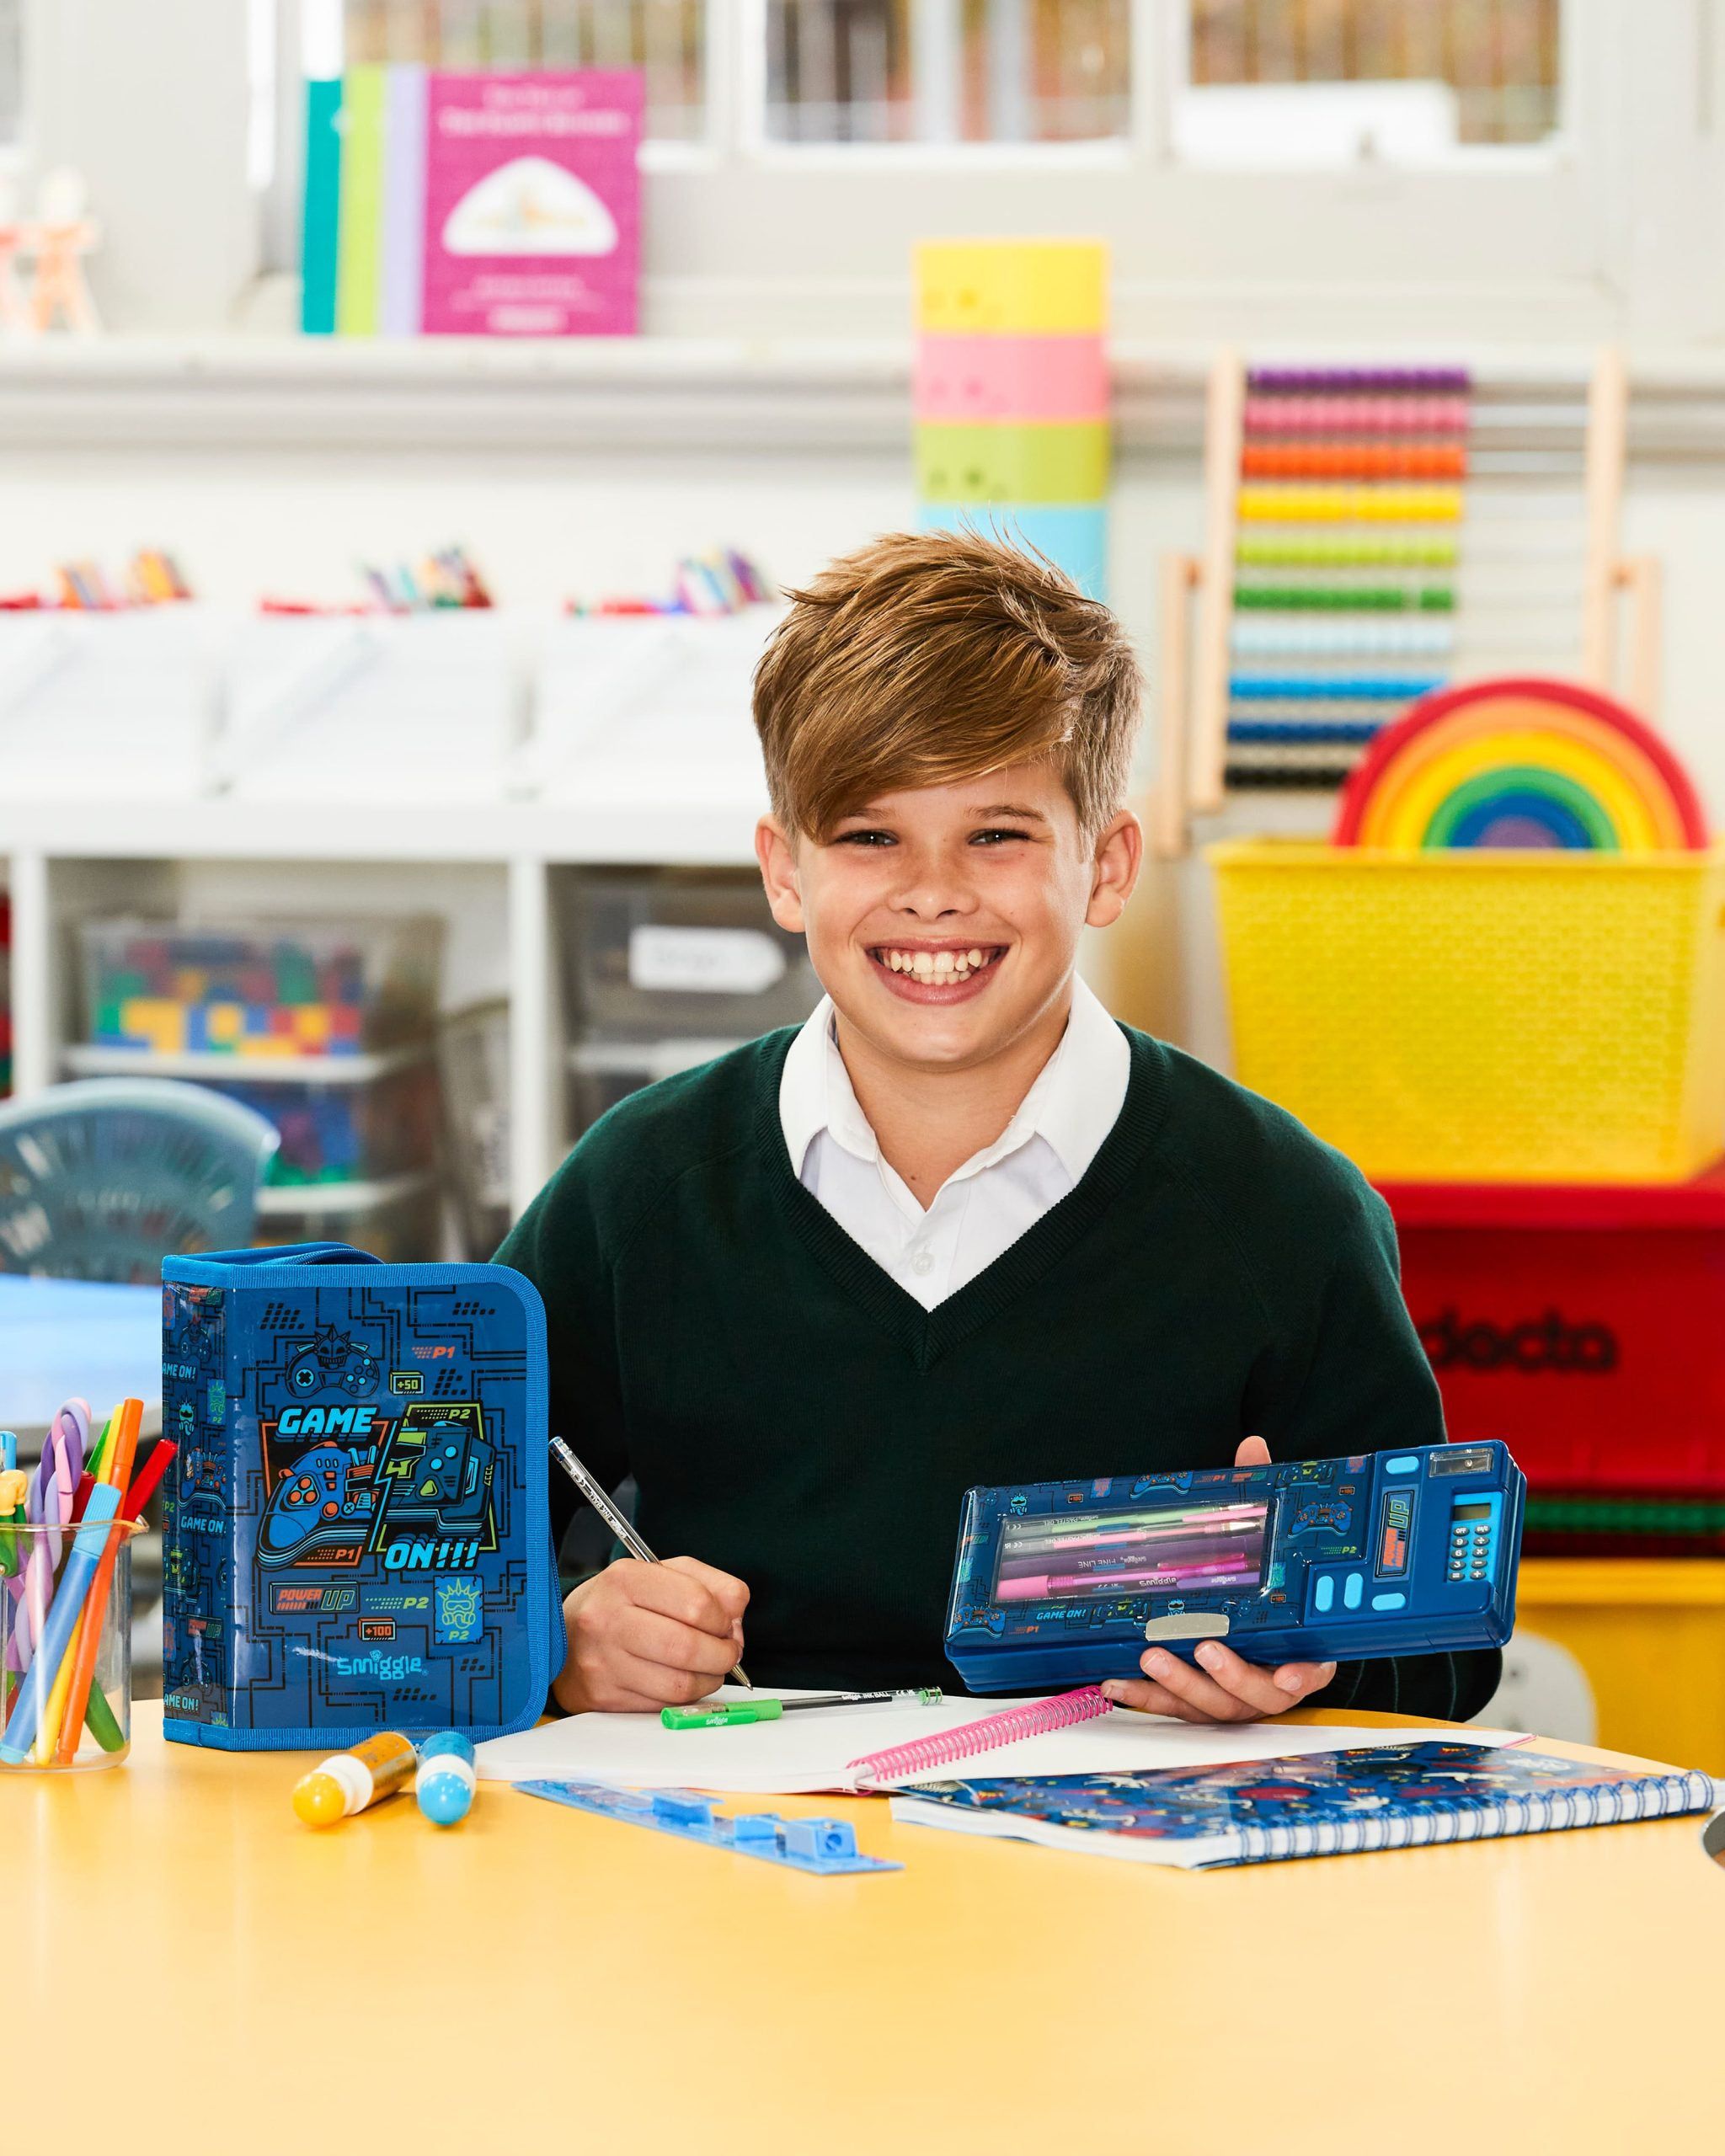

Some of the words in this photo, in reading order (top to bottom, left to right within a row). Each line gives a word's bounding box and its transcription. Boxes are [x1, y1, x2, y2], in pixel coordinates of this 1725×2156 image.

[432, 1346, 456, 1358] P1
[162, 1362, 177, 1377] AME
[179, 1364, 196, 1380] ON!
[397, 1380, 419, 1390] +50
[448, 1409, 470, 1419] P2
[278, 1407, 377, 1434] GAME
[164, 1501, 175, 1513] P2
[1388, 1499, 1410, 1529] UP
[180, 1515, 207, 1531] GAME
[335, 1549, 355, 1560] P1
[384, 1542, 479, 1570] ON!!!
[1078, 1561, 1096, 1569] LINE
[279, 1589, 323, 1602] POWER
[321, 1590, 355, 1610] UP
[403, 1597, 429, 1609] P2
[1036, 1611, 1065, 1620] GAME
[1065, 1609, 1087, 1618] ON!
[365, 1626, 392, 1636] +100
[448, 1630, 468, 1641] P2
[1026, 1625, 1039, 1634] P1
[163, 1694, 180, 1709] AME
[182, 1697, 199, 1711] ON!
